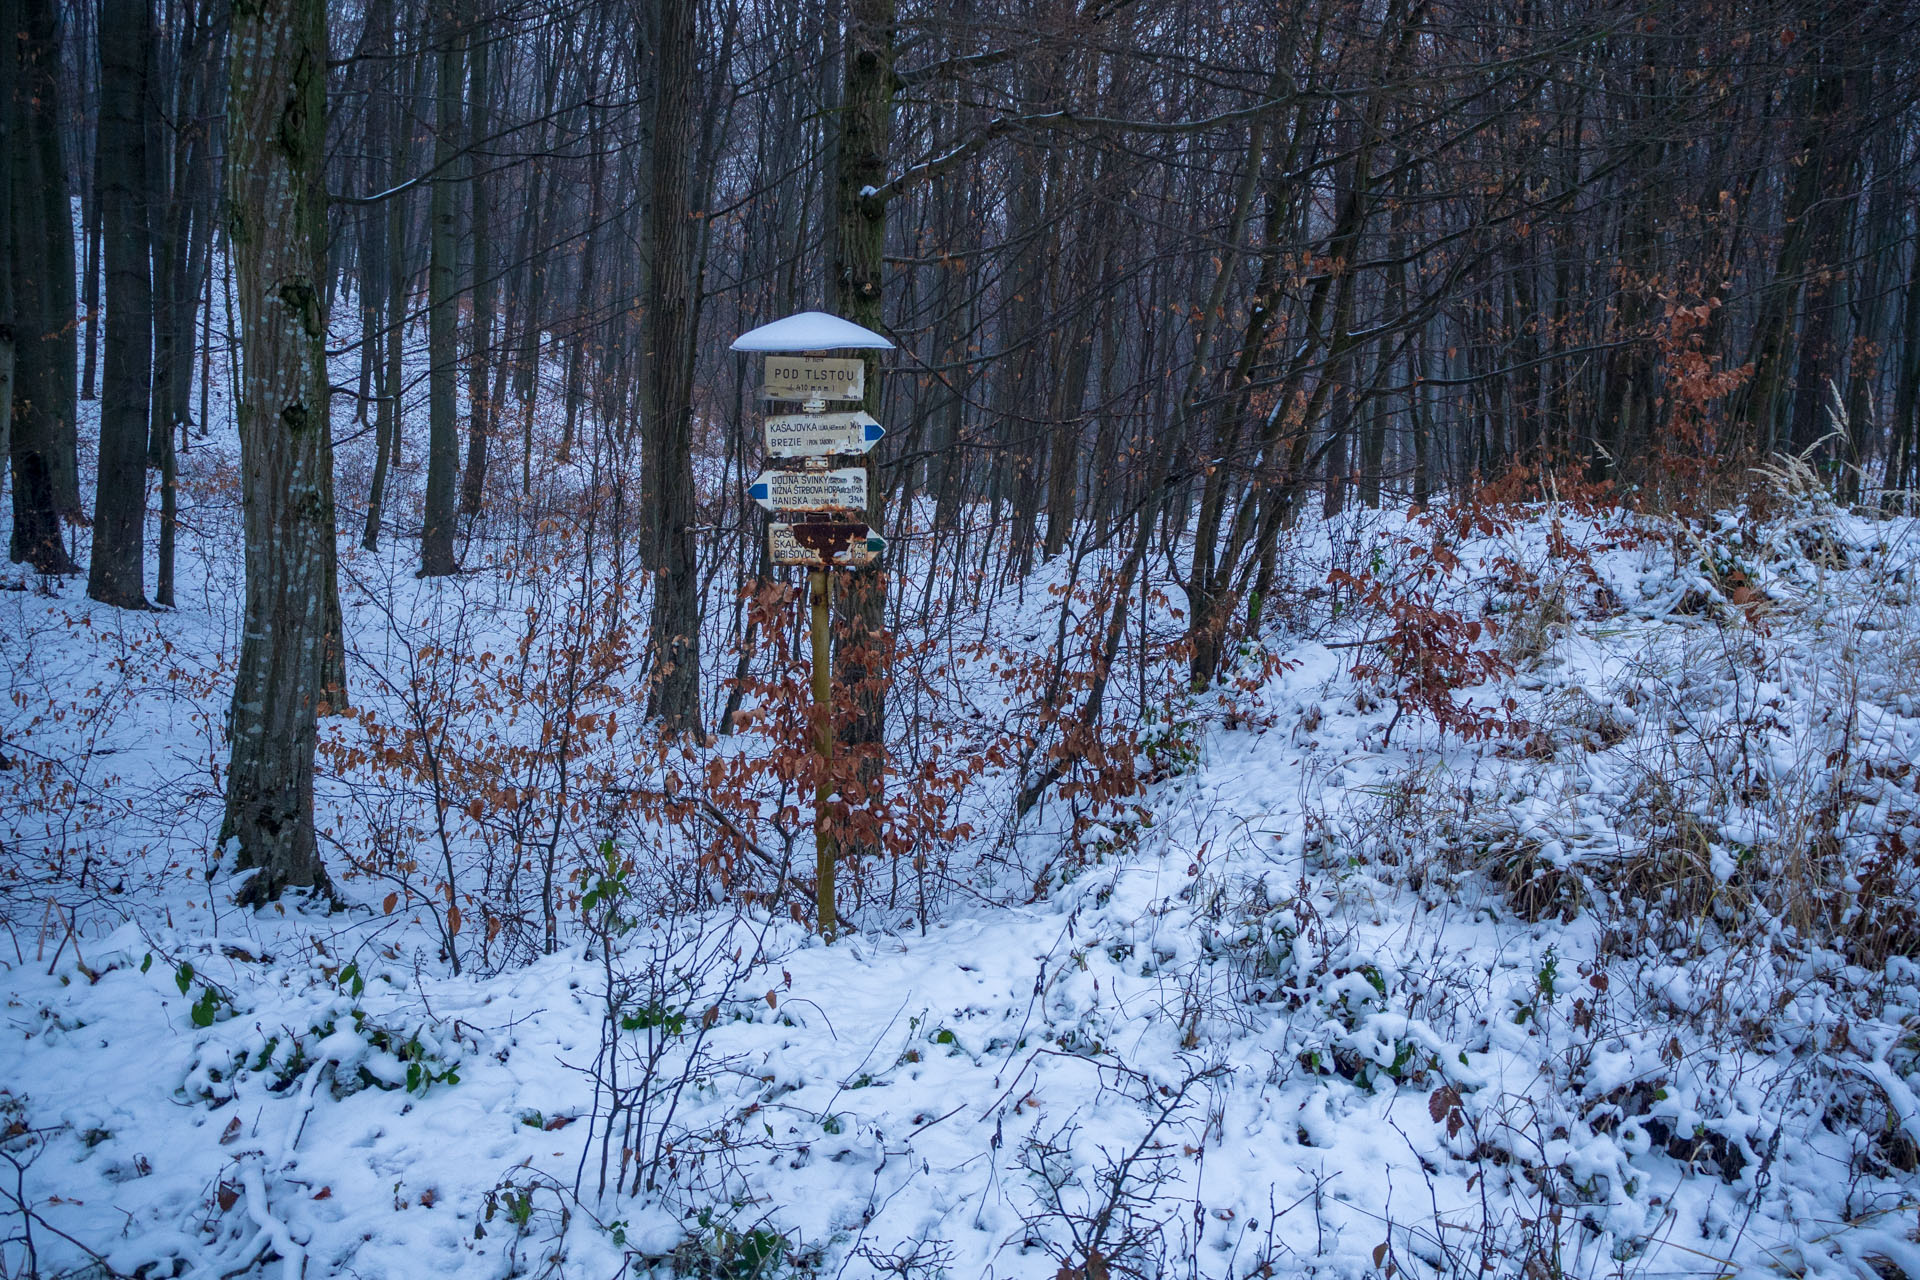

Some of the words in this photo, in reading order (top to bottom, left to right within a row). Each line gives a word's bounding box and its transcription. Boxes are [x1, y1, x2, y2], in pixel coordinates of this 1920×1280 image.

[774, 368, 799, 379] POD
[806, 370, 854, 381] TLSTOU
[770, 421, 817, 433] KAŠAJOVKA
[771, 438, 802, 447] BREZIE
[771, 475, 799, 485] DOLINA
[801, 475, 829, 484] SVINKY
[772, 496, 808, 505] HANISKA
[774, 548, 816, 559] OBIŠOVCE
